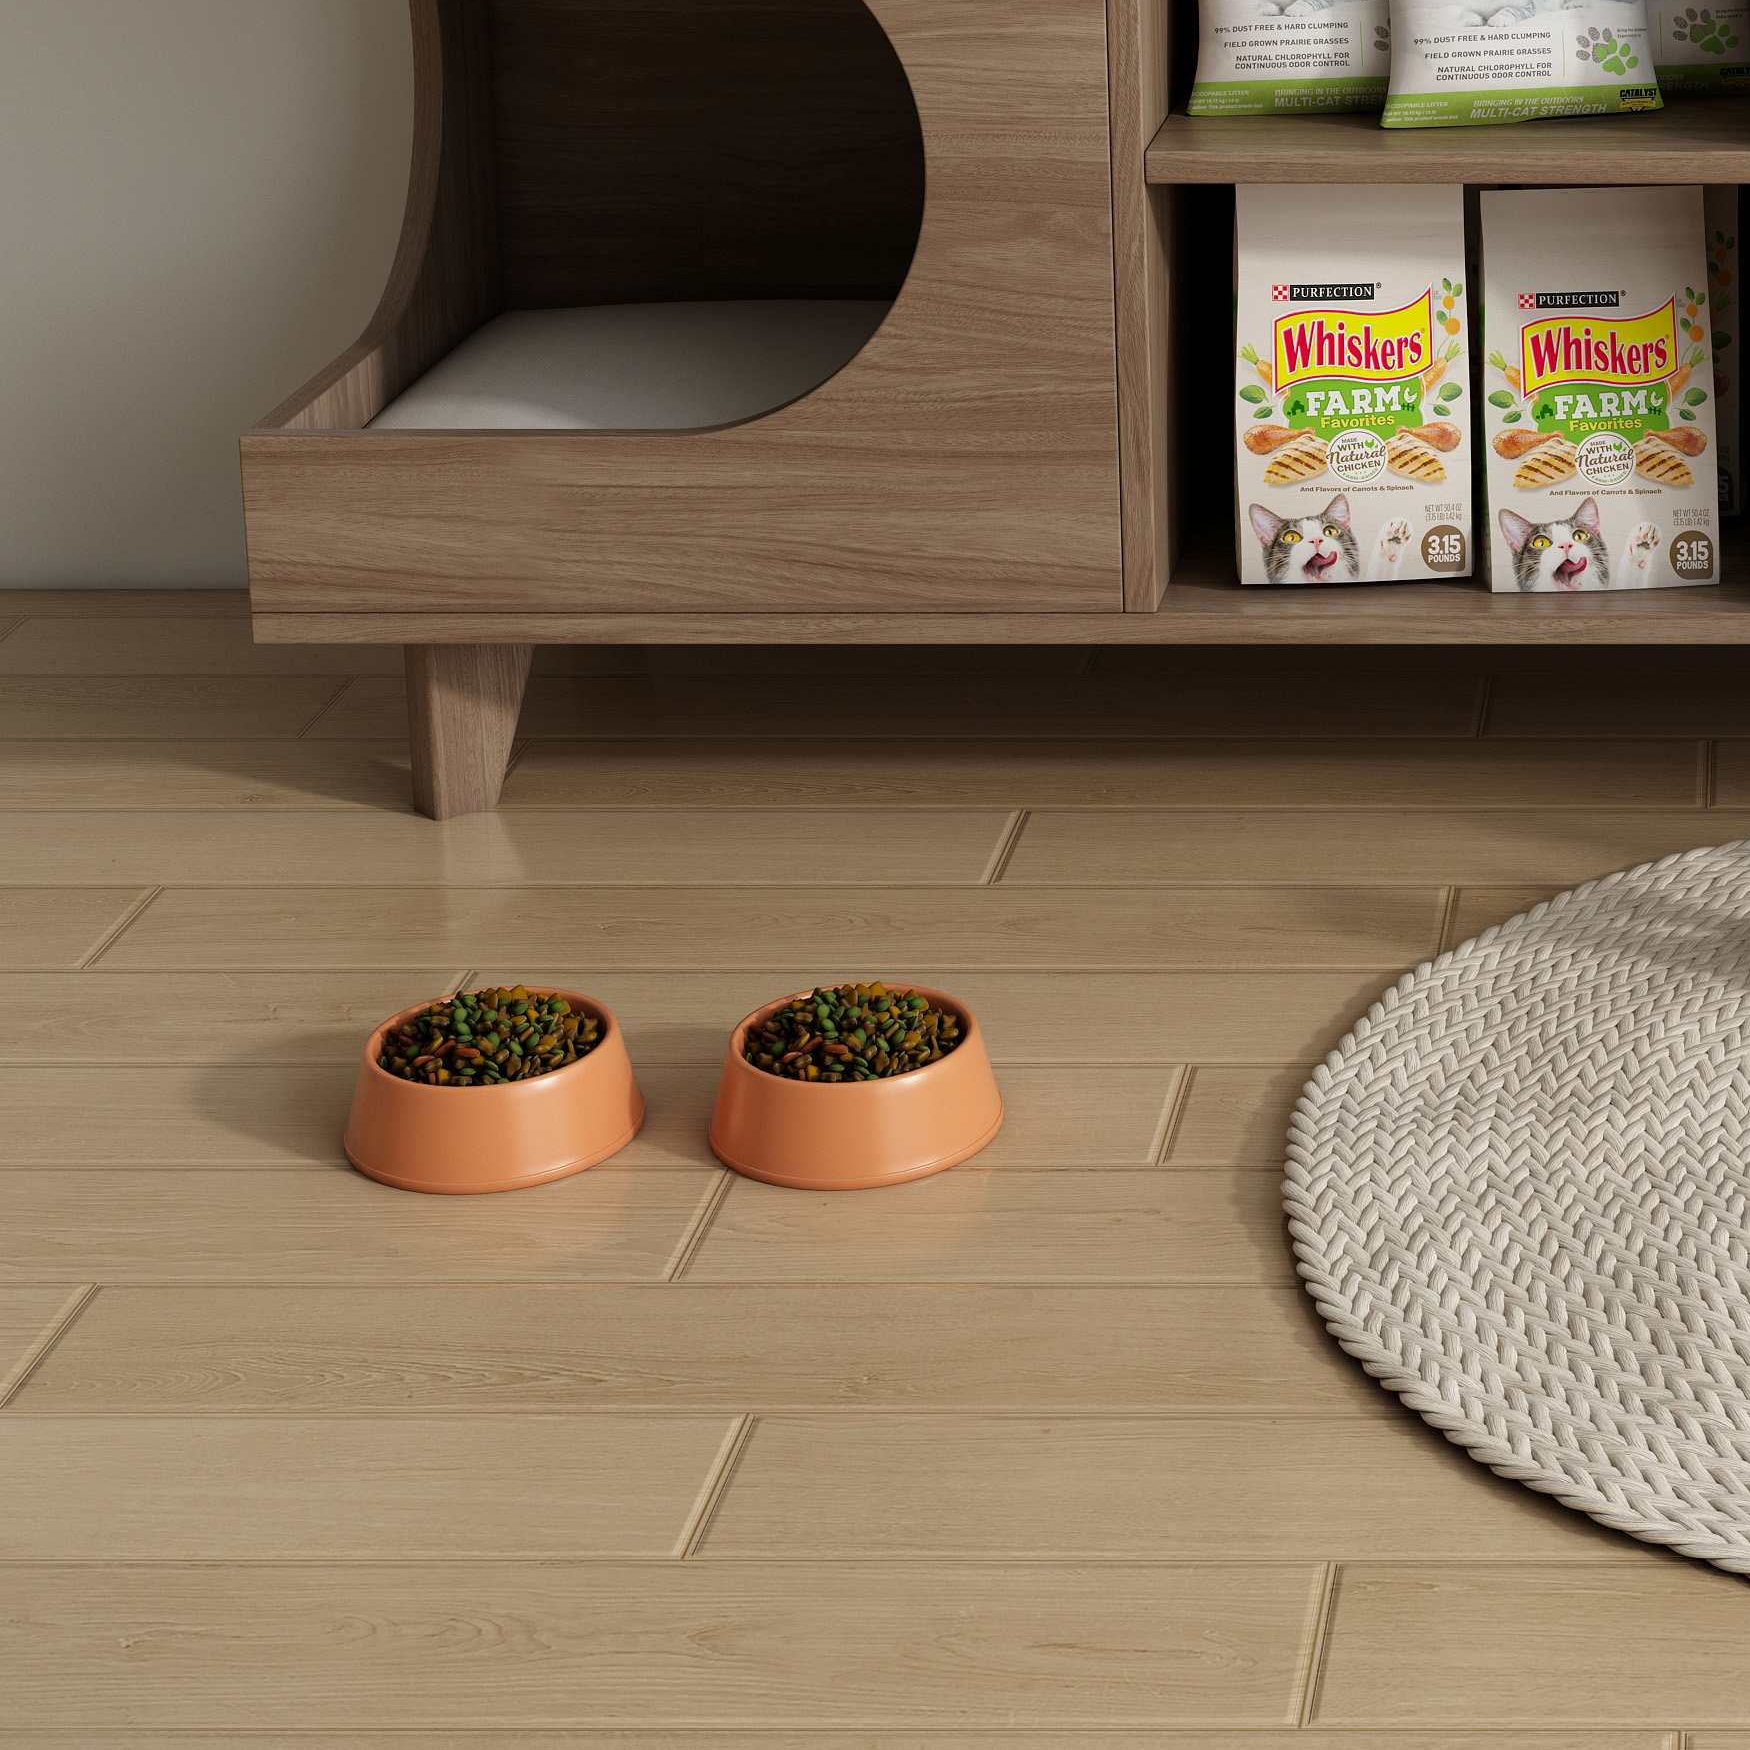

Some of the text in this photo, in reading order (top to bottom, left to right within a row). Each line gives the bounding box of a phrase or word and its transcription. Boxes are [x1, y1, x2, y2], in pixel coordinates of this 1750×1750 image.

[1414, 37, 1432, 45] 99%
[1434, 35, 1455, 44] DUST
[1457, 34, 1478, 42] FREE
[1488, 33, 1509, 41] HARD
[1511, 31, 1551, 40] CLUMPING
[1425, 48, 1551, 60] FIELD GROWN PRAIRIE GRASSES
[1437, 65, 1476, 73] NATURAL
[1478, 63, 1535, 71] CHLOROPHYLL
[1436, 70, 1551, 81] CONTINUOUS ODOR CONTROL
[1471, 106, 1537, 119] MULTI-CAT
[1539, 104, 1607, 117] STRENGTH
[1293, 286, 1372, 297] PURFECTION
[1539, 294, 1616, 305] PURFECTION
[1283, 321, 1421, 373] Whiskers
[1530, 327, 1666, 378] Whiskers
[1306, 386, 1401, 416] FARM
[1555, 390, 1648, 420] FARM
[1321, 415, 1394, 429] Favorites
[1569, 418, 1642, 432] Favorites
[1338, 442, 1364, 451] WITH
[1586, 445, 1612, 454] WITH
[1326, 446, 1386, 464] Natural
[1575, 449, 1634, 468] Natural
[1337, 460, 1381, 472] CHICKEN
[1586, 463, 1629, 476] CHICKEN
[1428, 535, 1461, 554] 3.15
[1677, 541, 1709, 561] 3.15
[1428, 554, 1461, 563] POUNDS
[1677, 561, 1708, 570] POUNDS
